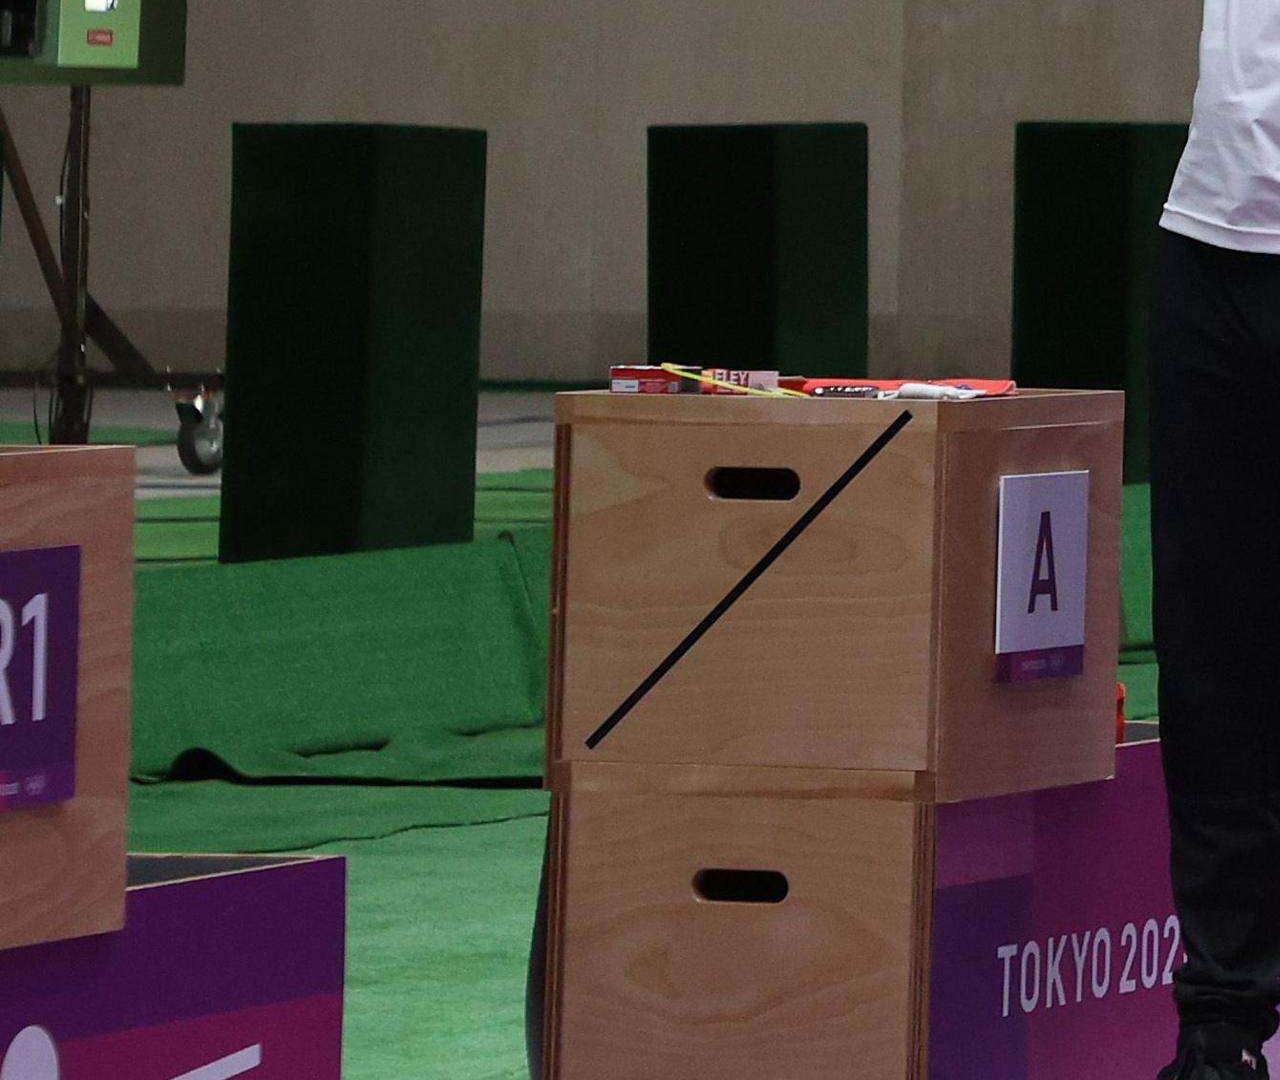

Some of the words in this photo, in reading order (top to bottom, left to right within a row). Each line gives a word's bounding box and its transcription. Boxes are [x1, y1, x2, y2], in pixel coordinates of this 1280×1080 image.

[1027, 510, 1059, 615] A
[997, 925, 1110, 1018] TOKYO
[1118, 914, 1187, 996] 202
